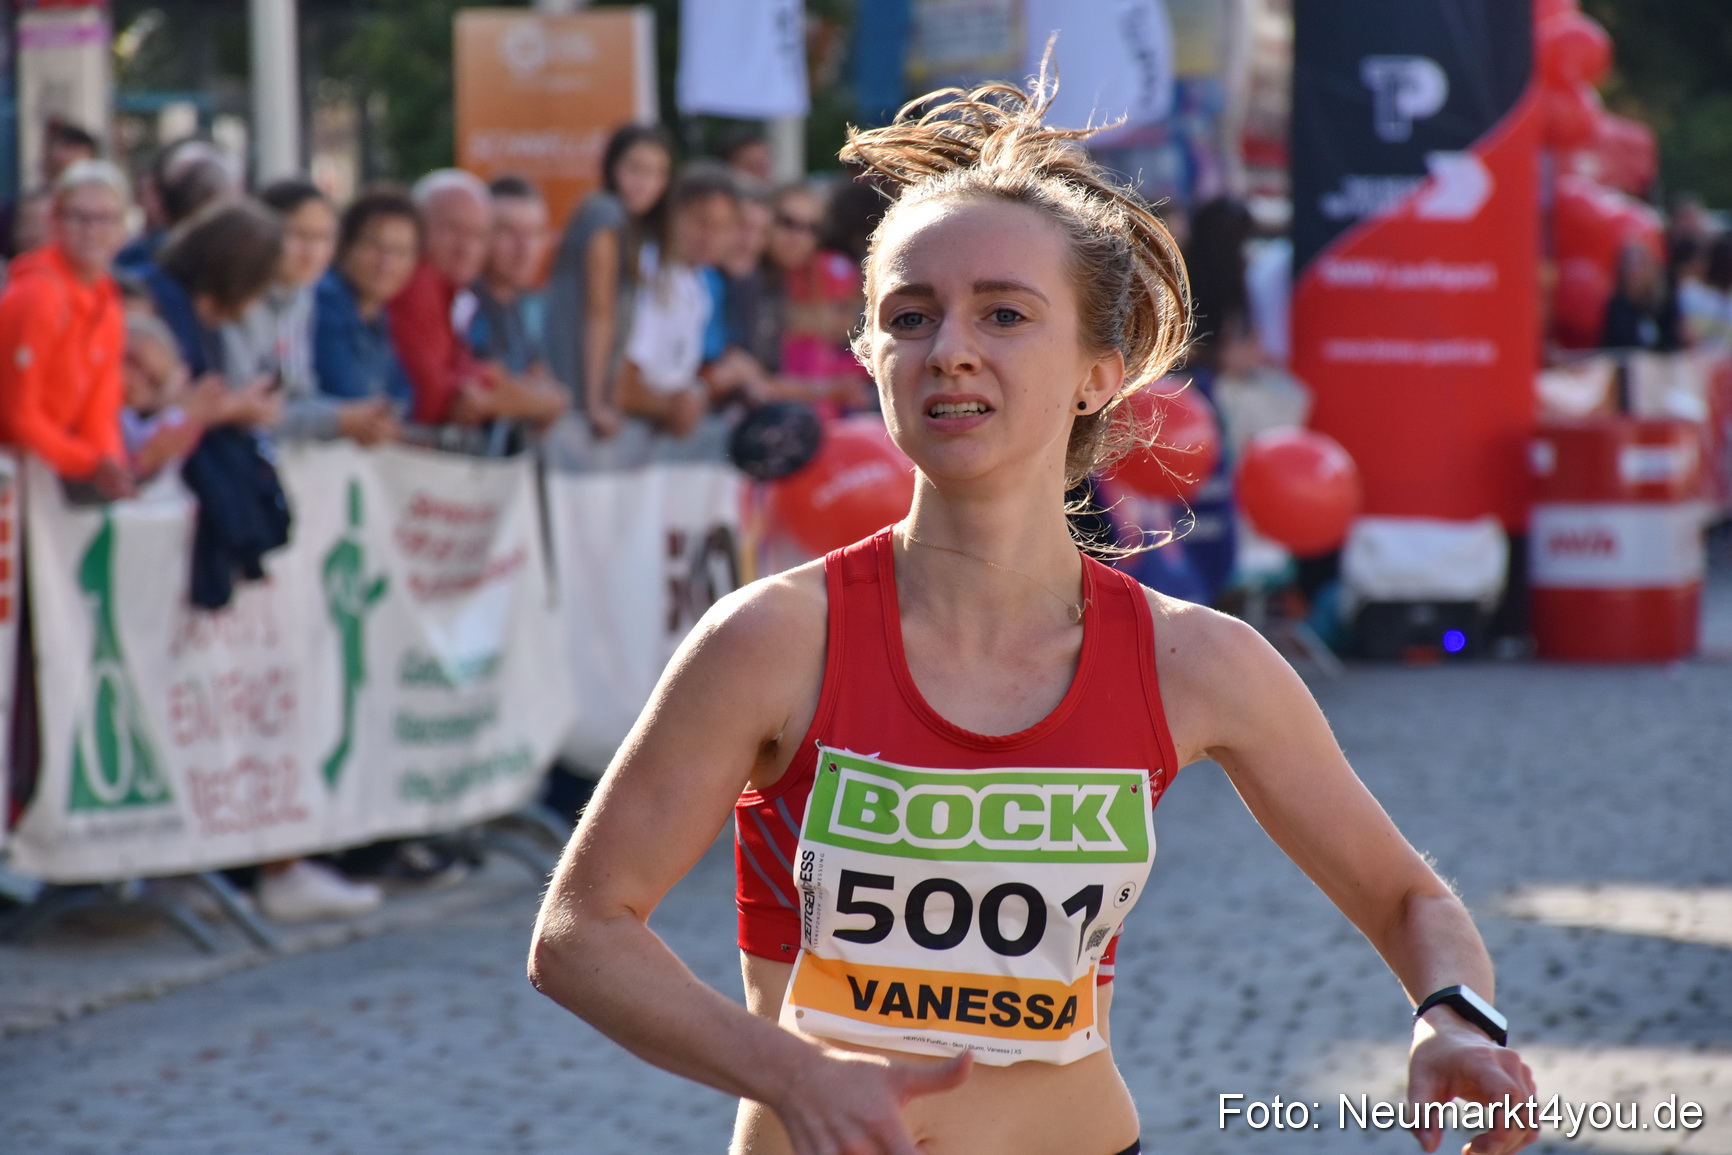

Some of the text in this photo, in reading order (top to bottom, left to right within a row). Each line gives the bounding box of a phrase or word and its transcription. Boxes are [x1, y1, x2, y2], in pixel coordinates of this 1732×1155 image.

[835, 774, 1120, 846] BOCK
[831, 868, 1104, 966] 5001
[1119, 888, 1130, 902] S
[846, 974, 1078, 1031] VANESSA
[926, 1038, 948, 1047] FunRun
[952, 1041, 964, 1049] 5km
[987, 1046, 1010, 1055] Vanessa
